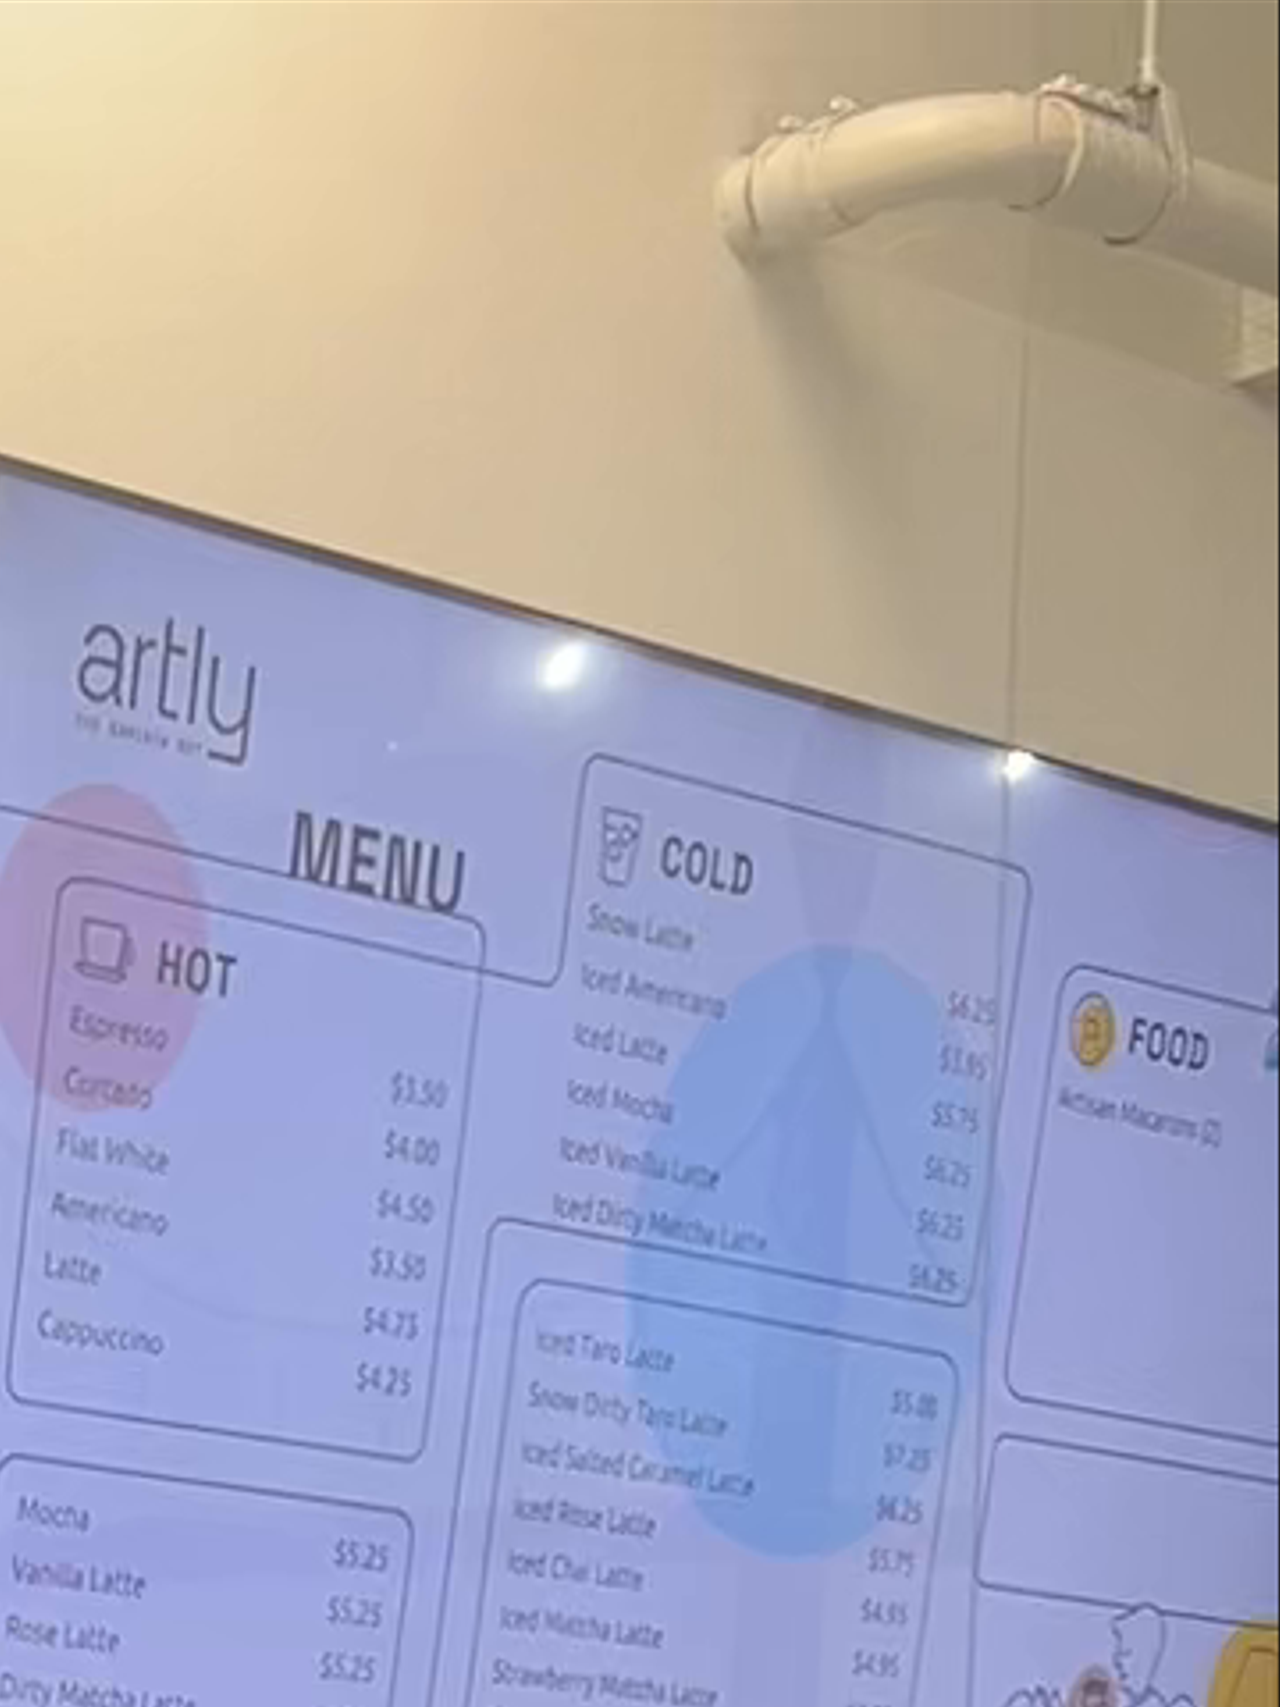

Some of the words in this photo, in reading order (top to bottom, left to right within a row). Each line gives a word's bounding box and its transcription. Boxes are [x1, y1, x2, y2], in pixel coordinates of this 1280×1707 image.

[78, 617, 256, 765] artly
[290, 810, 466, 914] MENU
[660, 835, 754, 896] COLD
[586, 903, 640, 938] Snow
[644, 917, 694, 952] Latte
[156, 941, 237, 998] HOT
[581, 962, 621, 995] Iced
[624, 974, 727, 1021] Americano
[69, 1005, 170, 1053] Espresso
[573, 1022, 615, 1055] Iced
[617, 1032, 669, 1066] Latte
[1129, 1017, 1209, 1071] FOOD
[63, 1066, 153, 1111] Cortado
[566, 1078, 608, 1110] Iced
[612, 1087, 674, 1126] Mocha
[56, 1127, 102, 1165] Flat
[105, 1137, 171, 1176] White
[384, 1130, 441, 1167] $4.00
[559, 1135, 601, 1167] Iced
[604, 1143, 669, 1181] Vanilla
[672, 1159, 722, 1193] Latte
[50, 1191, 170, 1238] Americano
[552, 1192, 594, 1222] Iced
[596, 1198, 642, 1236] Dirty
[648, 1210, 715, 1250] Matcha
[719, 1223, 768, 1254] Latte
[43, 1251, 103, 1287] Latte
[370, 1247, 428, 1283] $3.50
[36, 1308, 165, 1358] Cappuccino
[362, 1306, 420, 1341] $4.75
[536, 1329, 578, 1357] Iced
[579, 1333, 623, 1364] Taro
[624, 1345, 676, 1374] Latte
[355, 1362, 413, 1398] $4.25
[527, 1380, 581, 1413] Snow
[583, 1390, 634, 1426] Dirty
[637, 1400, 678, 1431] Taro
[679, 1407, 728, 1439] Latte
[520, 1439, 561, 1470] Iced
[564, 1446, 626, 1479] Salted
[627, 1455, 706, 1490] Caramel
[706, 1467, 756, 1499] Latte
[15, 1495, 90, 1533] Mocha
[513, 1496, 556, 1525] Iced
[558, 1502, 603, 1532] Rose
[606, 1509, 658, 1540] Latte
[11, 1554, 85, 1592] Vanilla
[89, 1566, 147, 1600] Latte
[333, 1537, 390, 1574] $5.25
[506, 1548, 548, 1579] Iced
[550, 1552, 591, 1584] Chai
[594, 1562, 645, 1593] Latte
[5, 1614, 59, 1649] Rose
[63, 1621, 121, 1654] Latte
[326, 1595, 383, 1630] $5.25
[499, 1603, 541, 1633] Iced
[543, 1610, 612, 1644] Matcha
[615, 1620, 664, 1650] Latte
[319, 1651, 376, 1685] $5.25
[491, 1657, 595, 1699] Strawberry
[598, 1671, 667, 1706] Matcha
